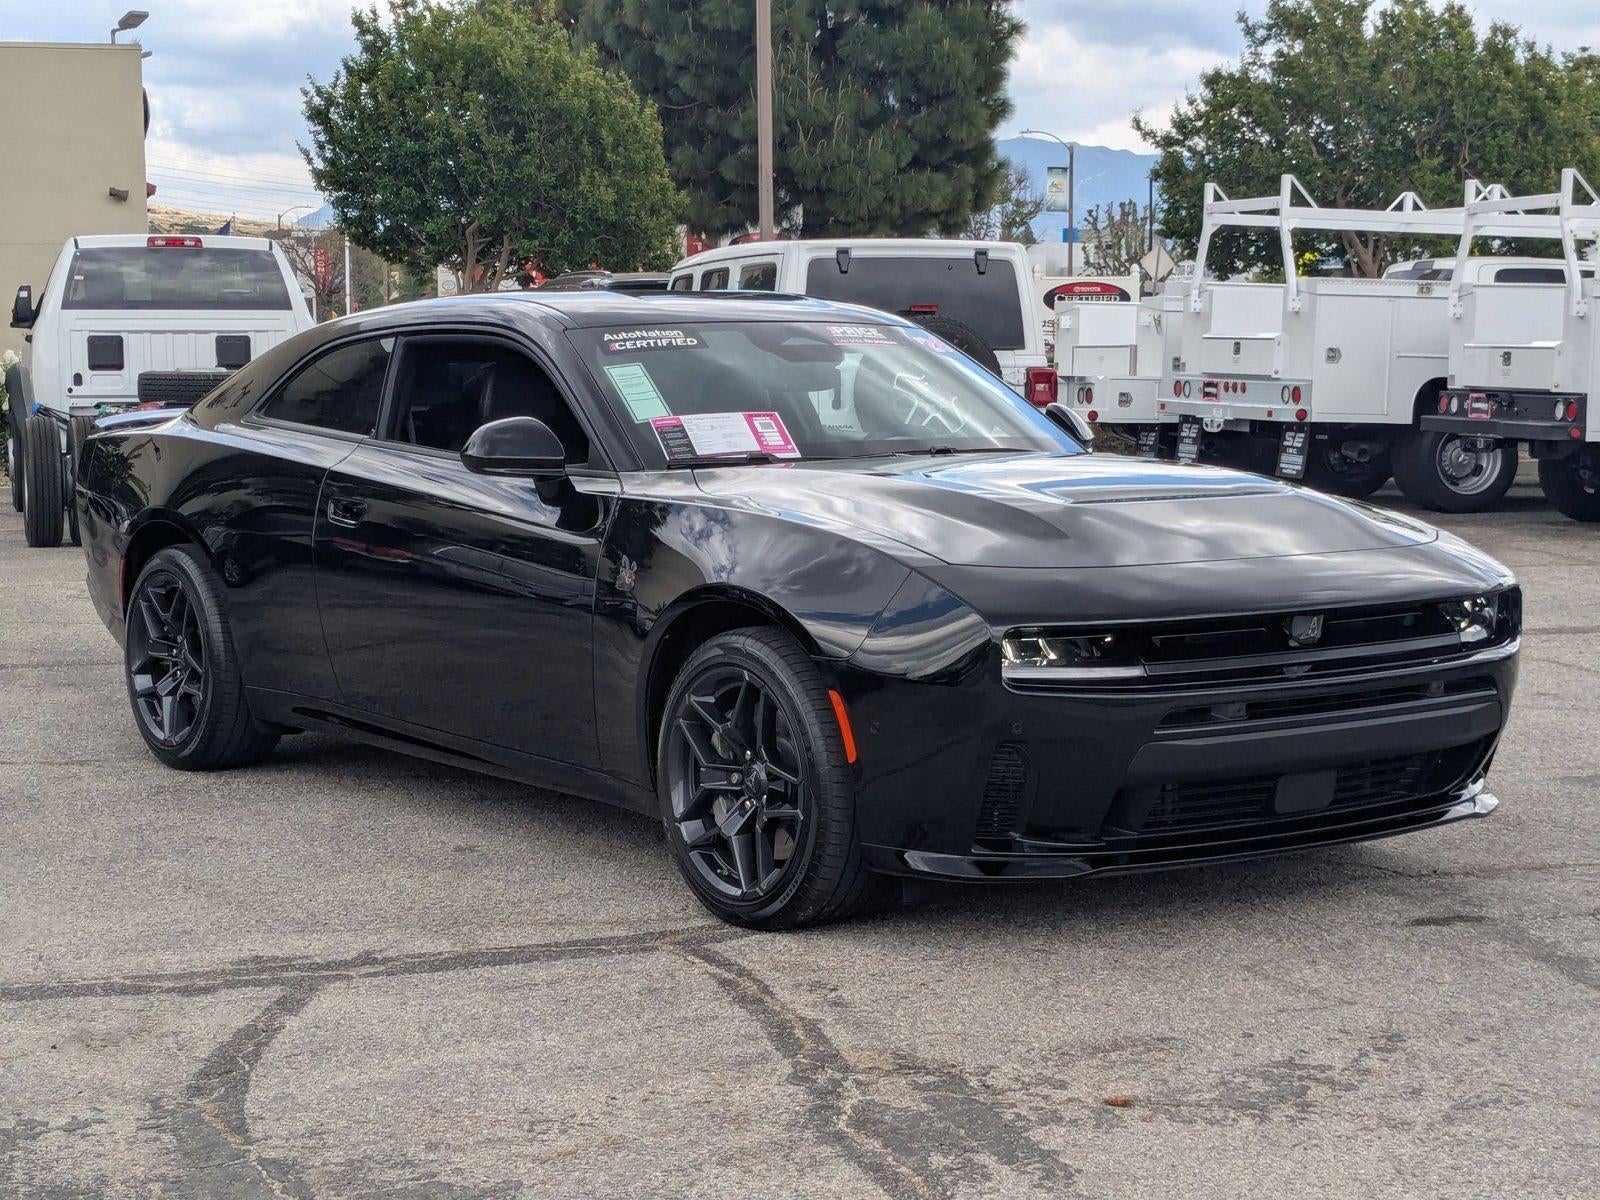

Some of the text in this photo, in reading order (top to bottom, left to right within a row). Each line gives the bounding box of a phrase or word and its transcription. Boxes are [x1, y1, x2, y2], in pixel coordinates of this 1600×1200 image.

[1054, 294, 1120, 302] CERTIFIED
[604, 329, 684, 341] AutoNation
[615, 338, 698, 350] CERTIFIED
[1283, 431, 1305, 447] SE
